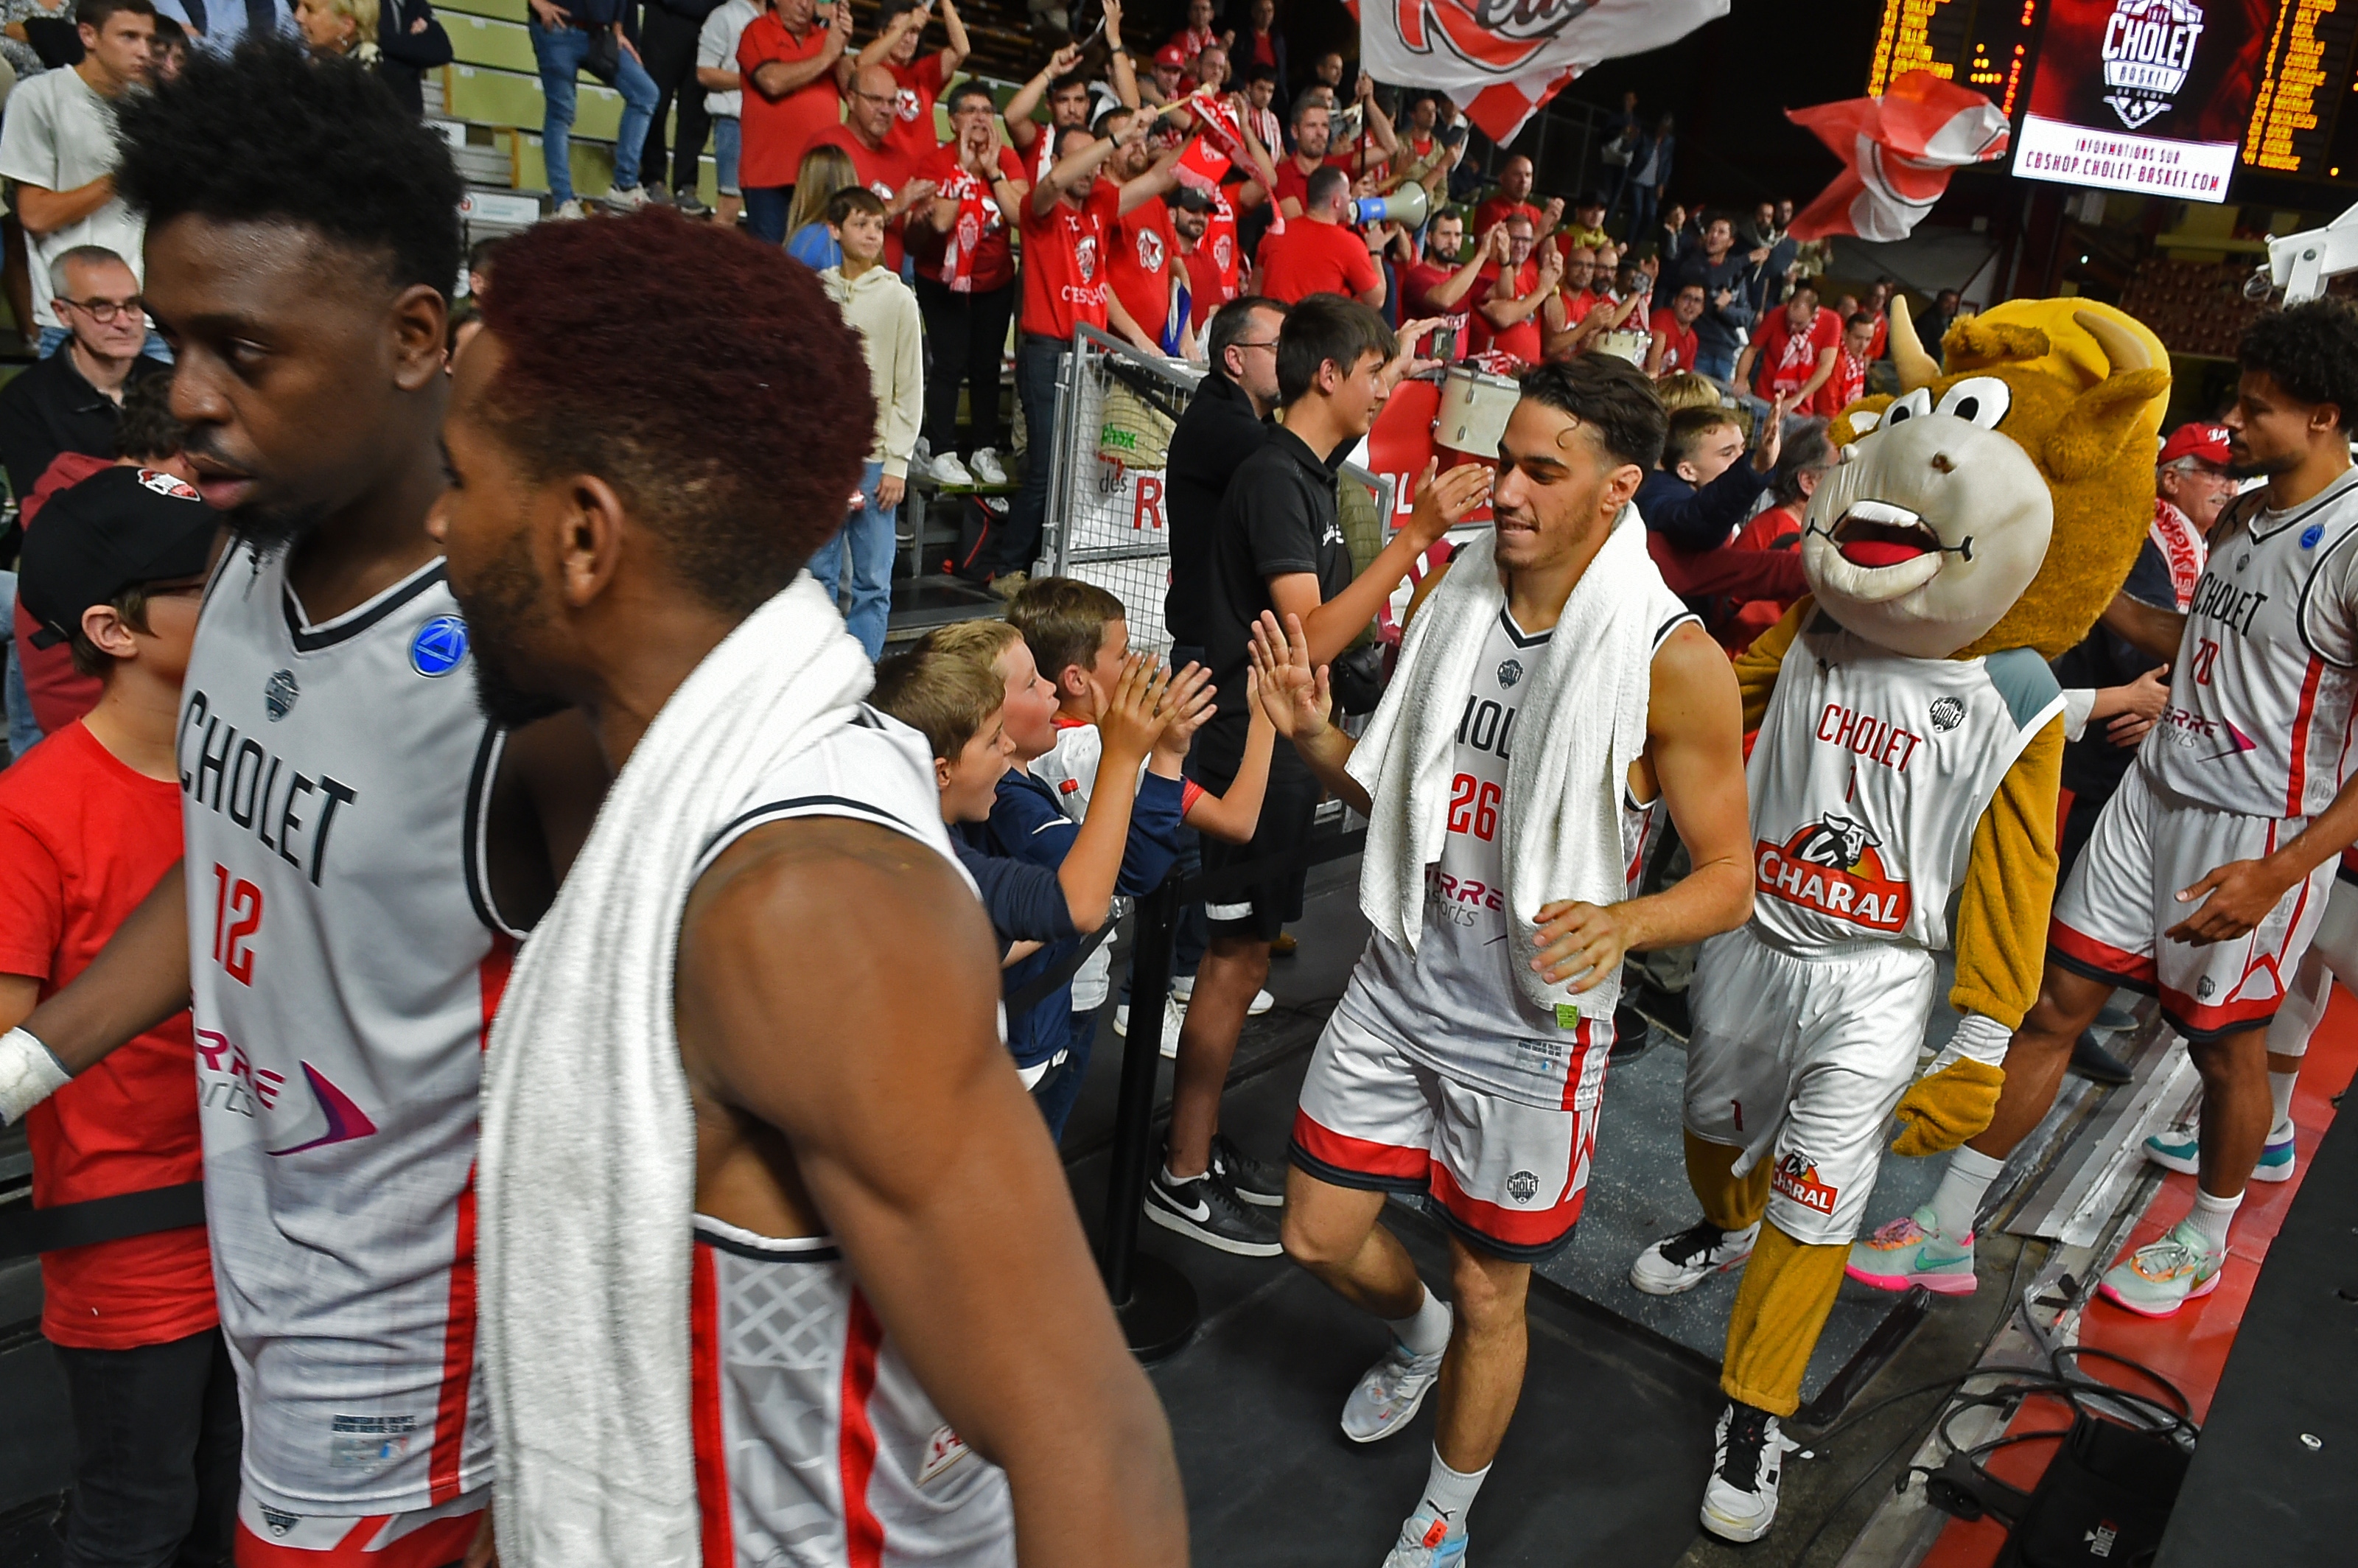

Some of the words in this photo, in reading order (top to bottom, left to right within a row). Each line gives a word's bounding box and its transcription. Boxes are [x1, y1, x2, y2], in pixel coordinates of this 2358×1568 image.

[2102, 12, 2204, 71] CHOLET
[1099, 469, 1127, 493] des
[2192, 571, 2269, 638] CHOLET
[1816, 703, 1923, 773] CHOLET
[1929, 699, 1966, 728] CHOLET
[177, 688, 358, 889] CHOLET
[1447, 771, 1502, 842] 26
[1844, 765, 1857, 803] 1
[1757, 851, 1900, 924] CHARAL
[211, 861, 264, 988] 12
[1731, 1099, 1743, 1132] 1
[1506, 1178, 1540, 1192] CHOLET
[1771, 1166, 1831, 1210] CHARAL
